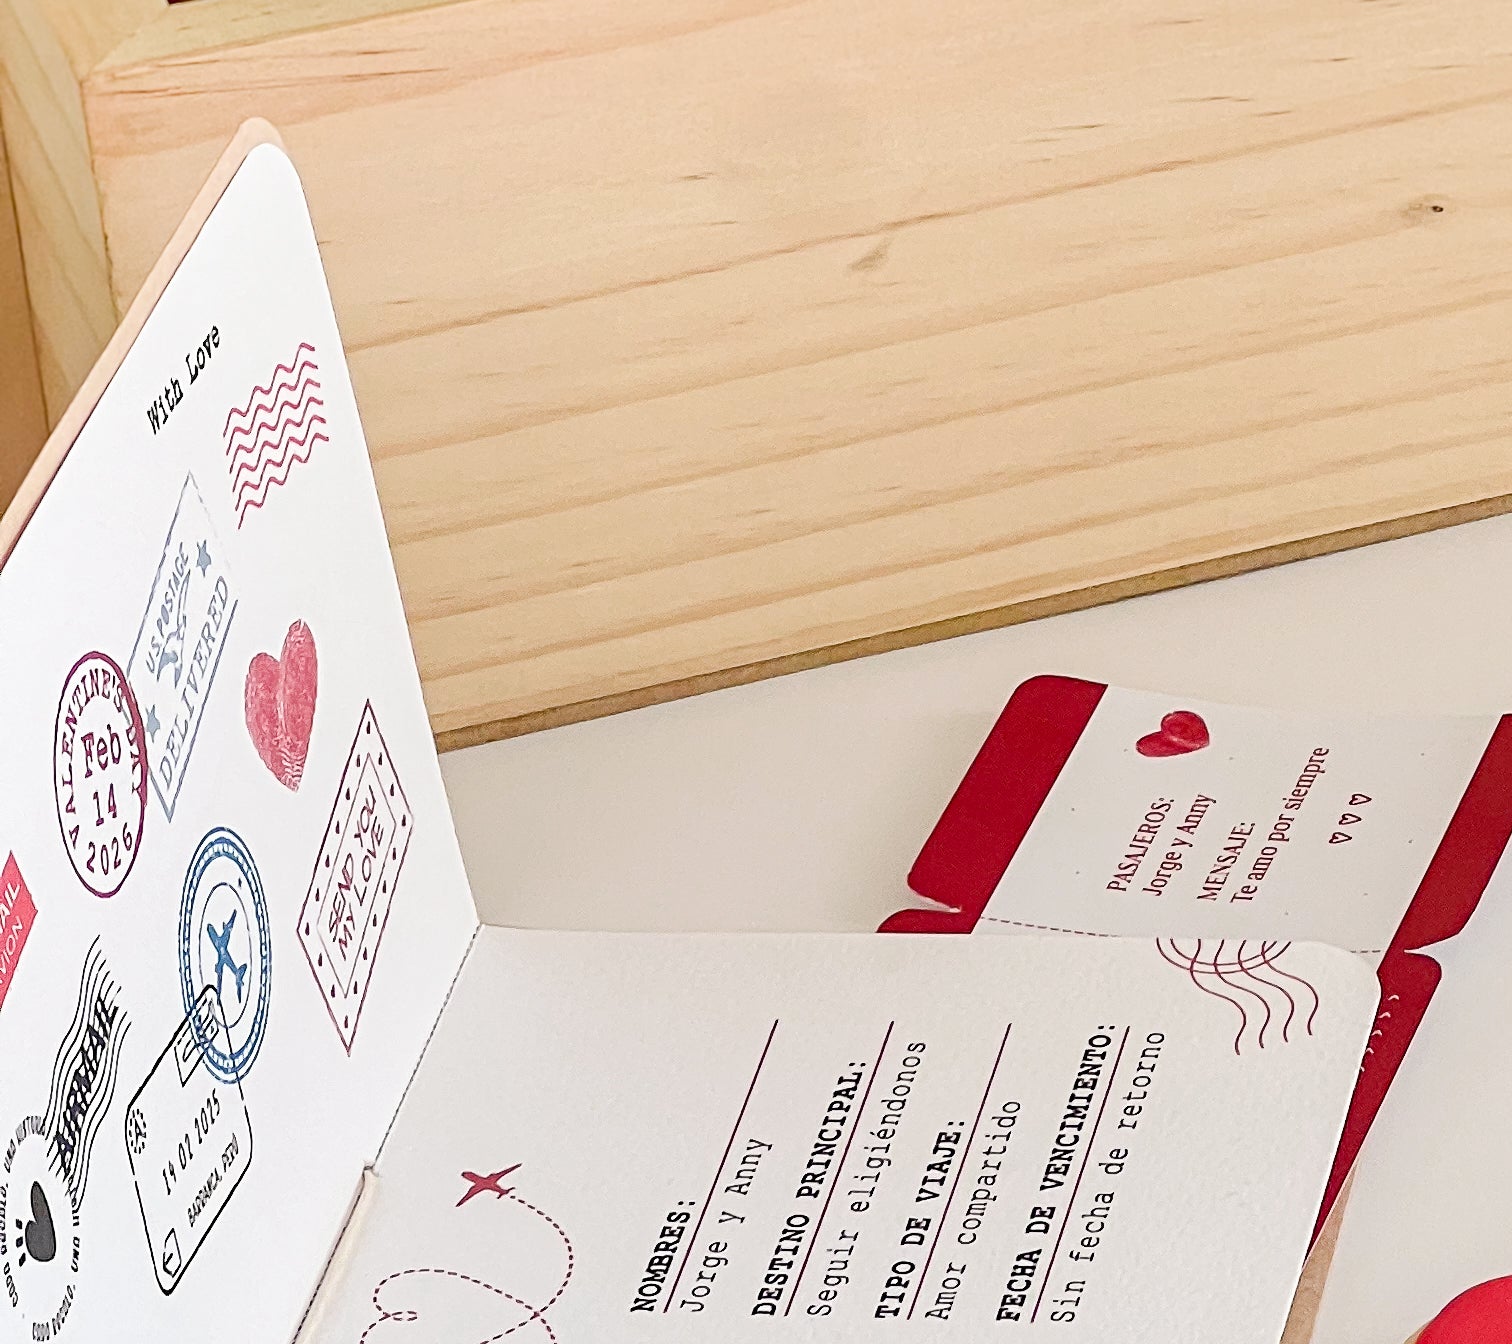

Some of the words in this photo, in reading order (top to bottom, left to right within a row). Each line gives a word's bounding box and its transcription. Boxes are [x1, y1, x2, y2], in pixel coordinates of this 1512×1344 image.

[146, 376, 184, 436] With
[185, 324, 220, 386] Love
[159, 575, 229, 791] DELIVERED
[62, 668, 125, 850] VALENTINE'S
[81, 723, 122, 779] Feb
[86, 821, 133, 876] 2026
[93, 782, 118, 827] 14
[1106, 797, 1175, 892] PASAJEROS:
[1171, 837, 1194, 848] y
[1176, 793, 1217, 835] Anny
[1229, 884, 1258, 903] Te
[1247, 846, 1278, 881] amo
[1268, 813, 1295, 843] por
[1282, 747, 1330, 810] siempre
[328, 852, 355, 943] SEND
[353, 784, 376, 848] YOU
[338, 902, 356, 962] MY
[353, 815, 384, 907] LOVE
[1142, 851, 1183, 897] Jorge
[1196, 822, 1256, 901] MENSAJE:
[1039, 1025, 1117, 1191] VENCIMIENTO:
[718, 1210, 745, 1224] y
[724, 1138, 773, 1196] Anny
[752, 1214, 810, 1316] DESTINO
[796, 1062, 867, 1199] PRINCIPAL:
[806, 1229, 859, 1317] Seguir
[848, 1042, 927, 1213] eligiéndonos
[925, 1261, 967, 1321] Amor
[957, 1101, 1021, 1245] compartido
[1050, 1280, 1086, 1323] Sin
[1069, 1190, 1115, 1263] fecha
[1098, 1147, 1130, 1176] de
[1117, 1031, 1166, 1130] retorno
[630, 1200, 695, 1313] NOMBRES:
[875, 1260, 916, 1320] TIPO
[900, 1217, 931, 1246] DE
[916, 1121, 966, 1203] VIAJE:
[1025, 1206, 1057, 1235] DE
[680, 1241, 729, 1313] Jorge
[995, 1248, 1043, 1322] FECHA
